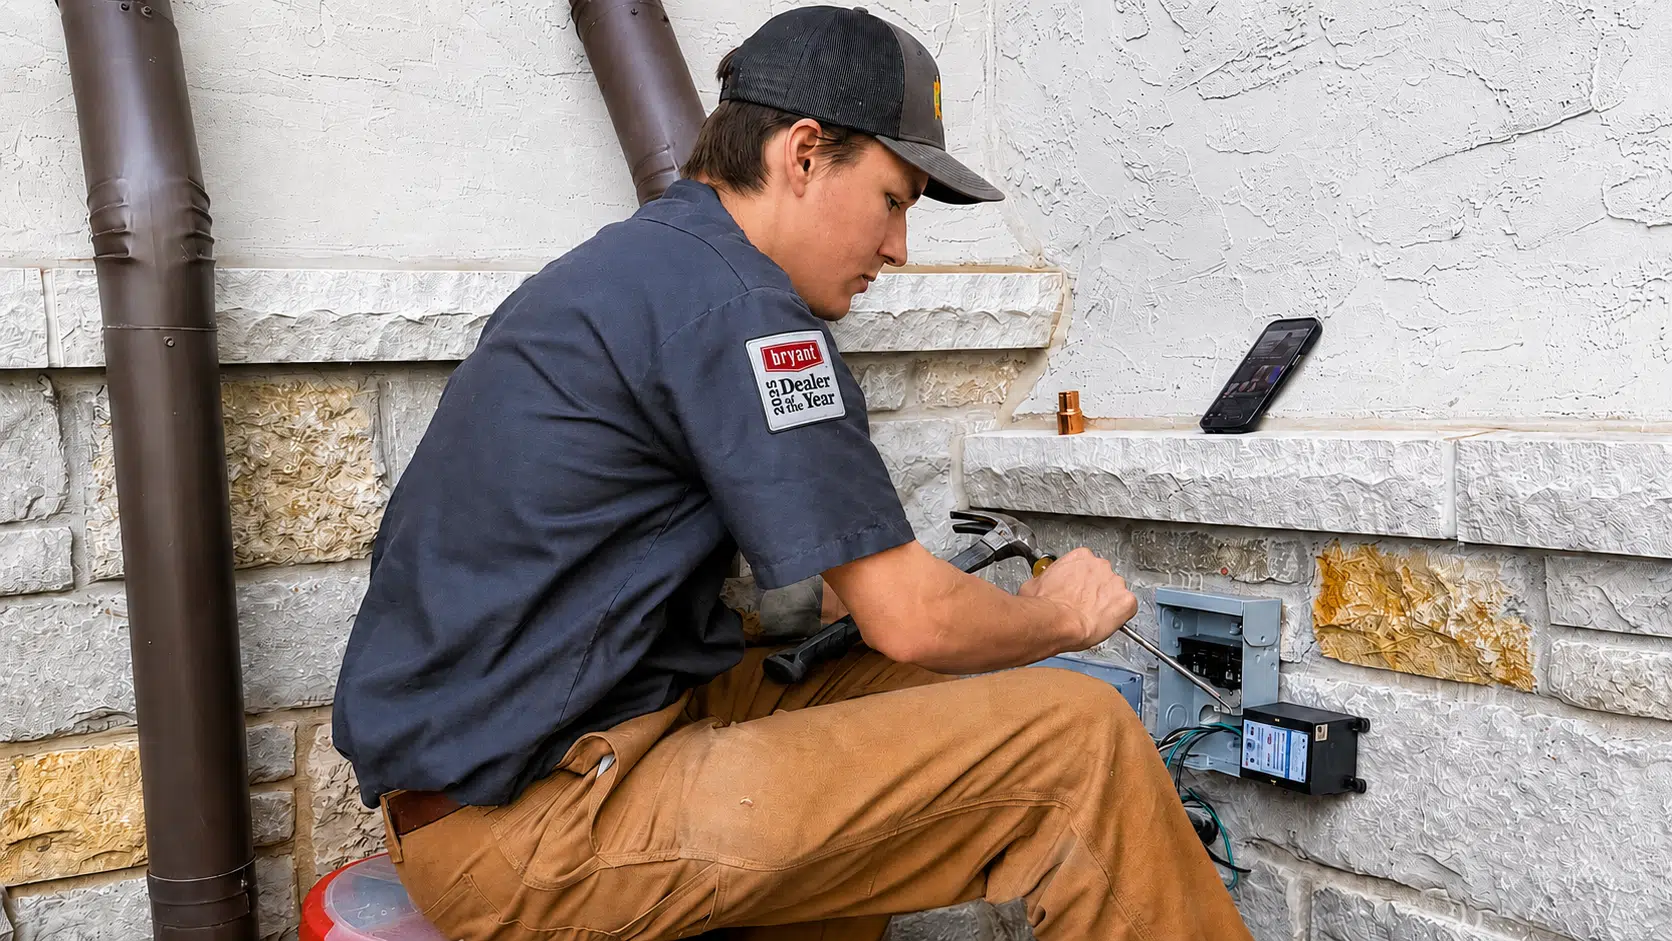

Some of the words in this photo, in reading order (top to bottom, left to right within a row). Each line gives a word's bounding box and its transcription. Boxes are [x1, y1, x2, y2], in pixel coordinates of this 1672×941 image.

[770, 344, 817, 366] bryant
[779, 373, 830, 395] Dealer
[766, 380, 785, 416] 2025
[786, 402, 804, 413] the
[802, 392, 835, 409] Year
